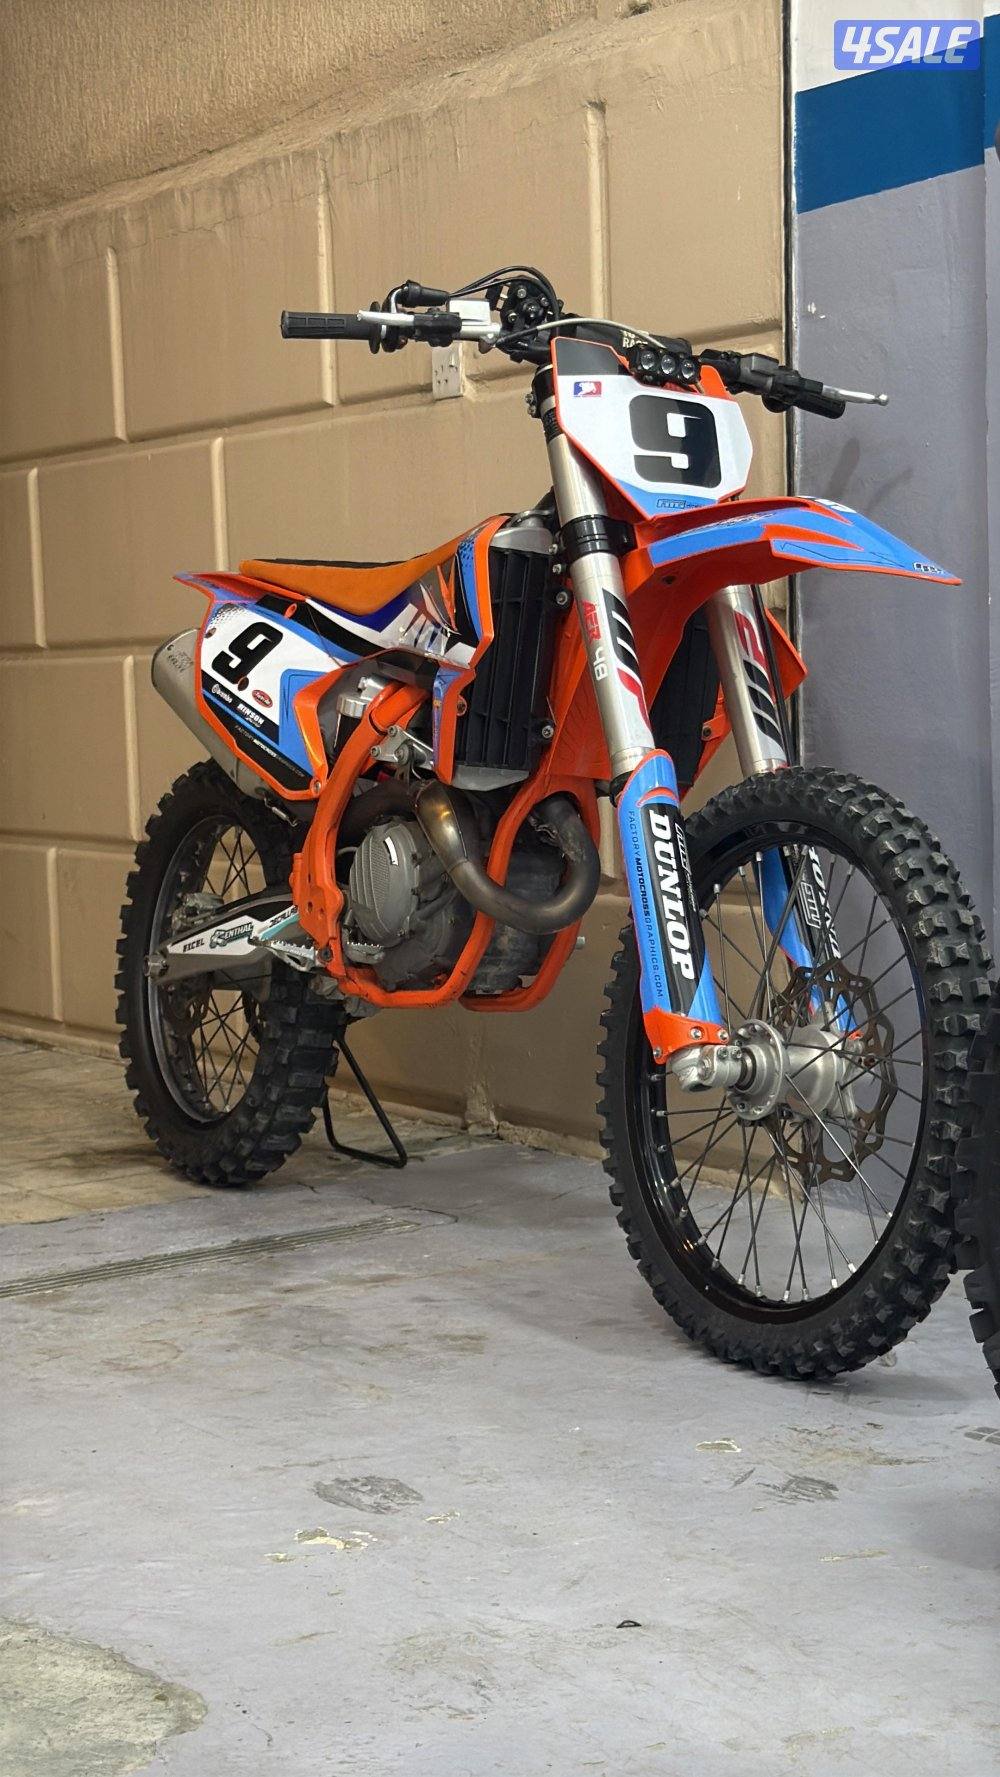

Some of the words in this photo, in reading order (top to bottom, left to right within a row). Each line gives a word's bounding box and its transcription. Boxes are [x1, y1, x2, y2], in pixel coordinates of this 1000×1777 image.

[628, 394, 722, 489] 9
[211, 621, 284, 685] 9
[593, 646, 609, 681] 48
[650, 808, 695, 980] DUNLOP
